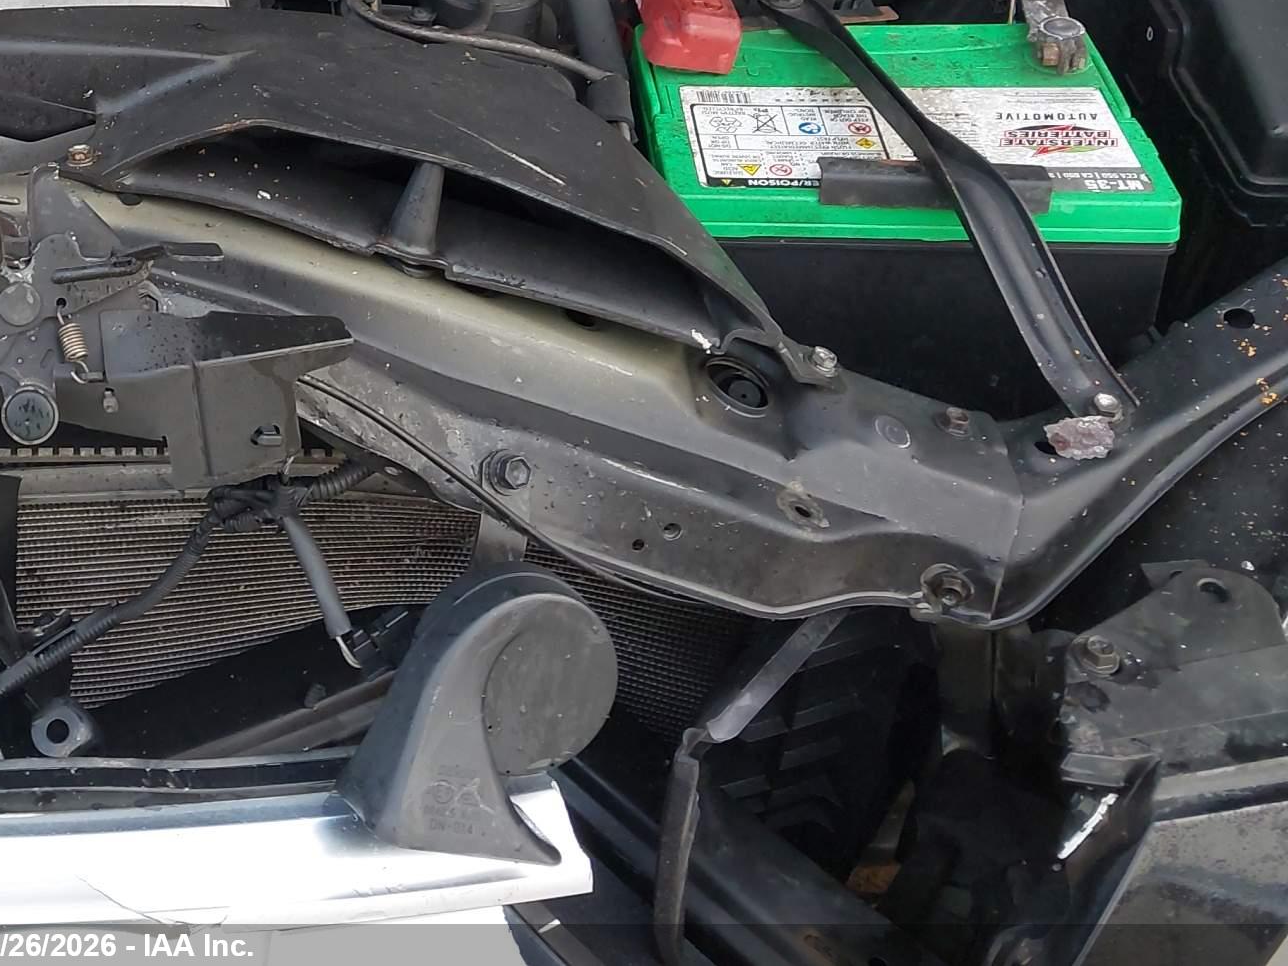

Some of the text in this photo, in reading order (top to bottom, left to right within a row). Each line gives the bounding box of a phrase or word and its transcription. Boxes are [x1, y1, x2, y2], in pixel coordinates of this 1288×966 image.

[995, 112, 1098, 121] AUTOMOTIVE
[1008, 130, 1108, 138] BATTERIES
[1004, 138, 1115, 146] INTERSTATE
[1083, 179, 1145, 191] MT-35
